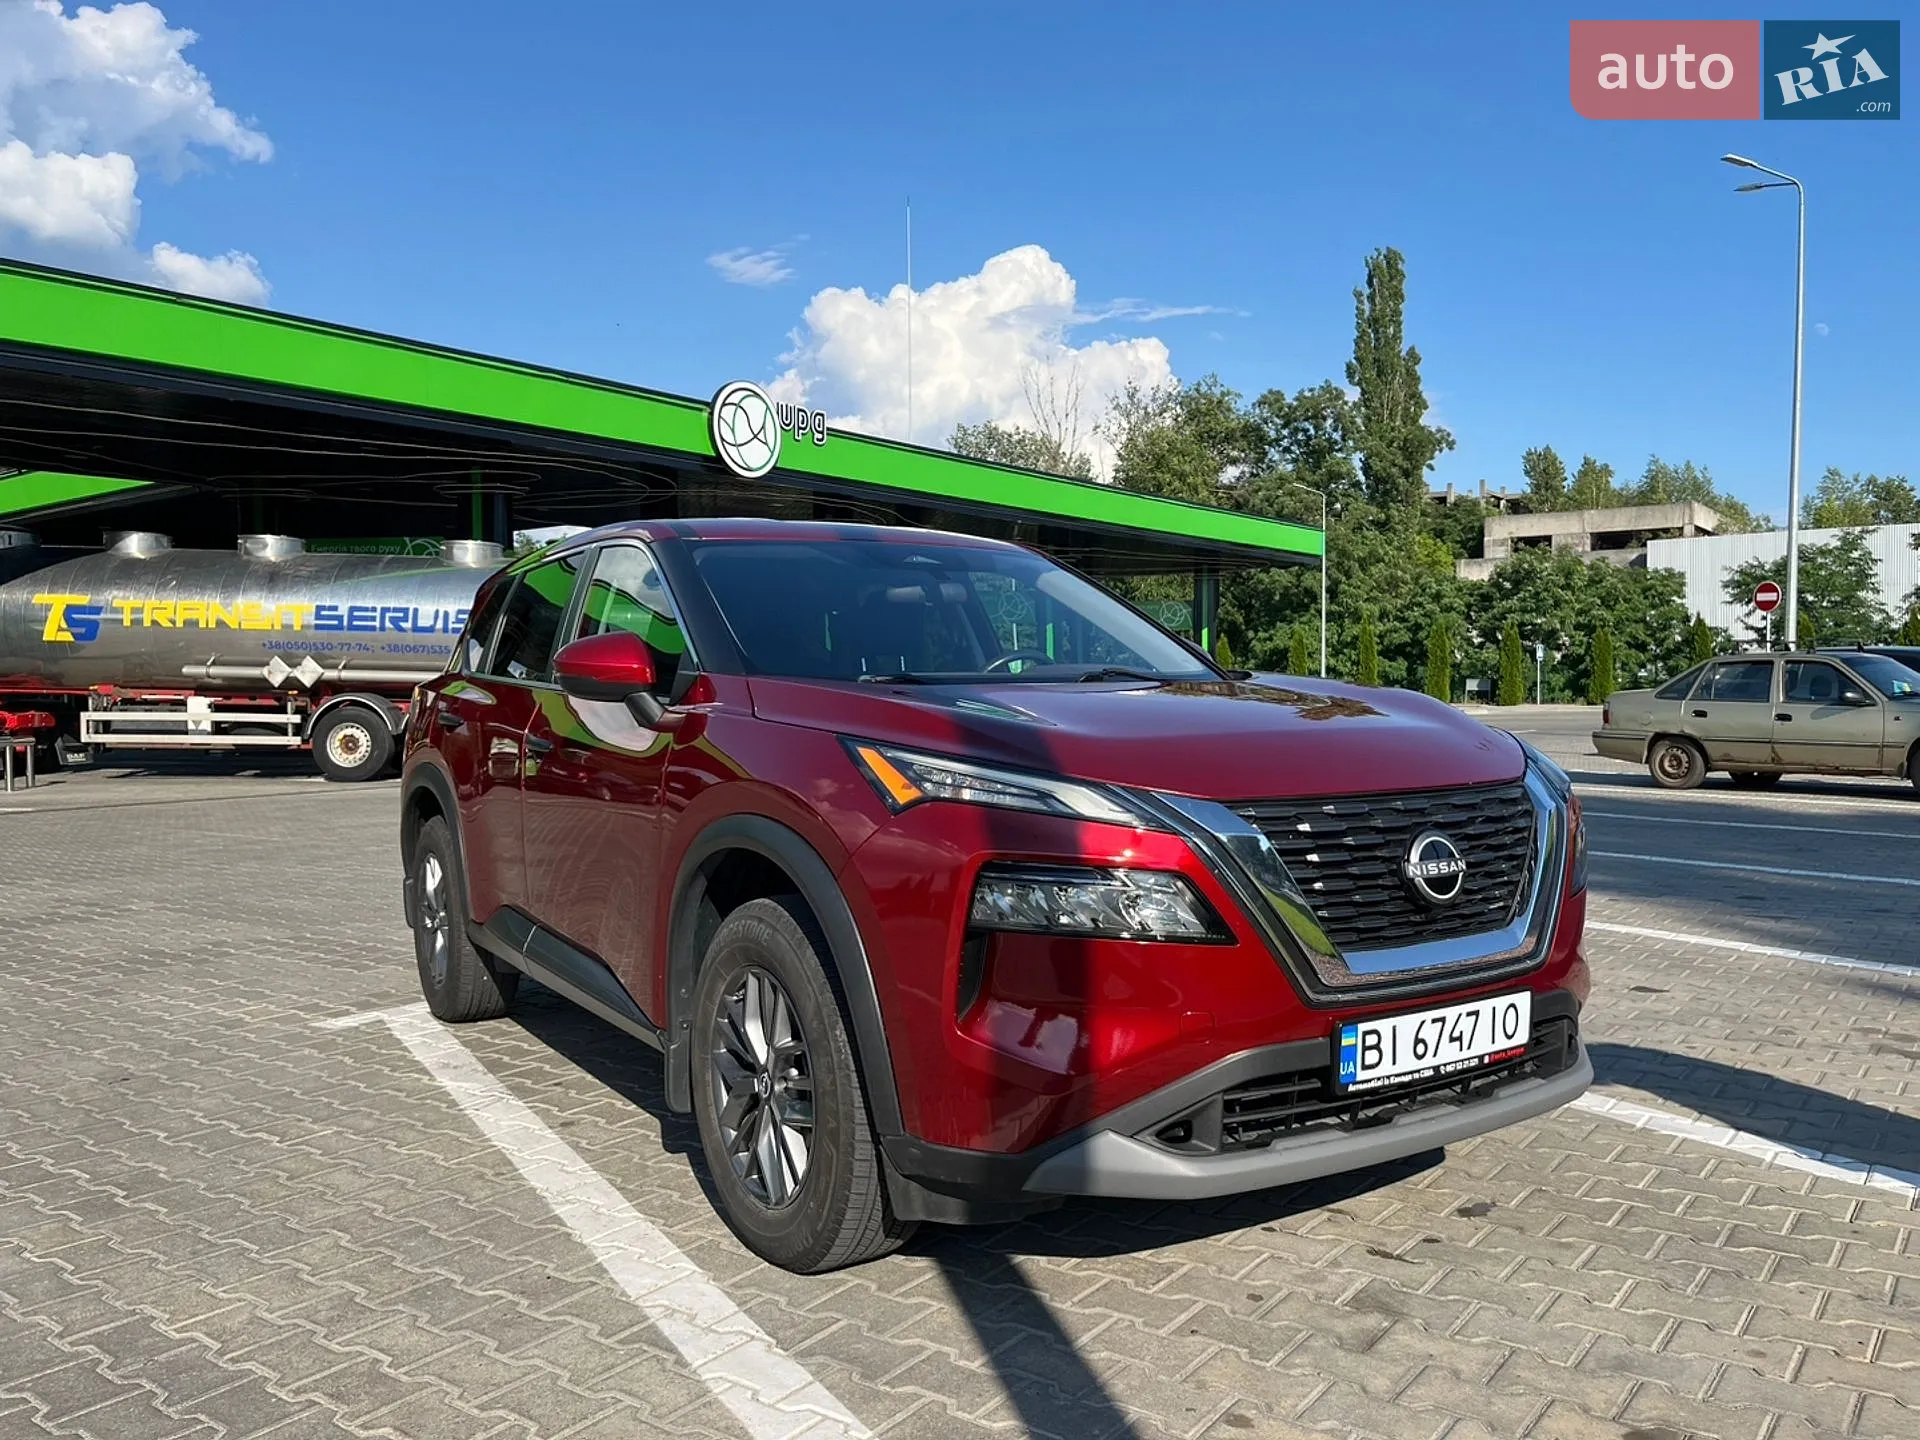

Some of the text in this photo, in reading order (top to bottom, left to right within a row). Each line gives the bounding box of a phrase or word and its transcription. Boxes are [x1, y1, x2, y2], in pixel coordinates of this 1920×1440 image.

[776, 401, 827, 447] upg
[1408, 859, 1466, 877] NISSAN
[1361, 1025, 1398, 1071] BI
[1412, 1009, 1481, 1060] 6747
[1340, 1061, 1356, 1075] UA
